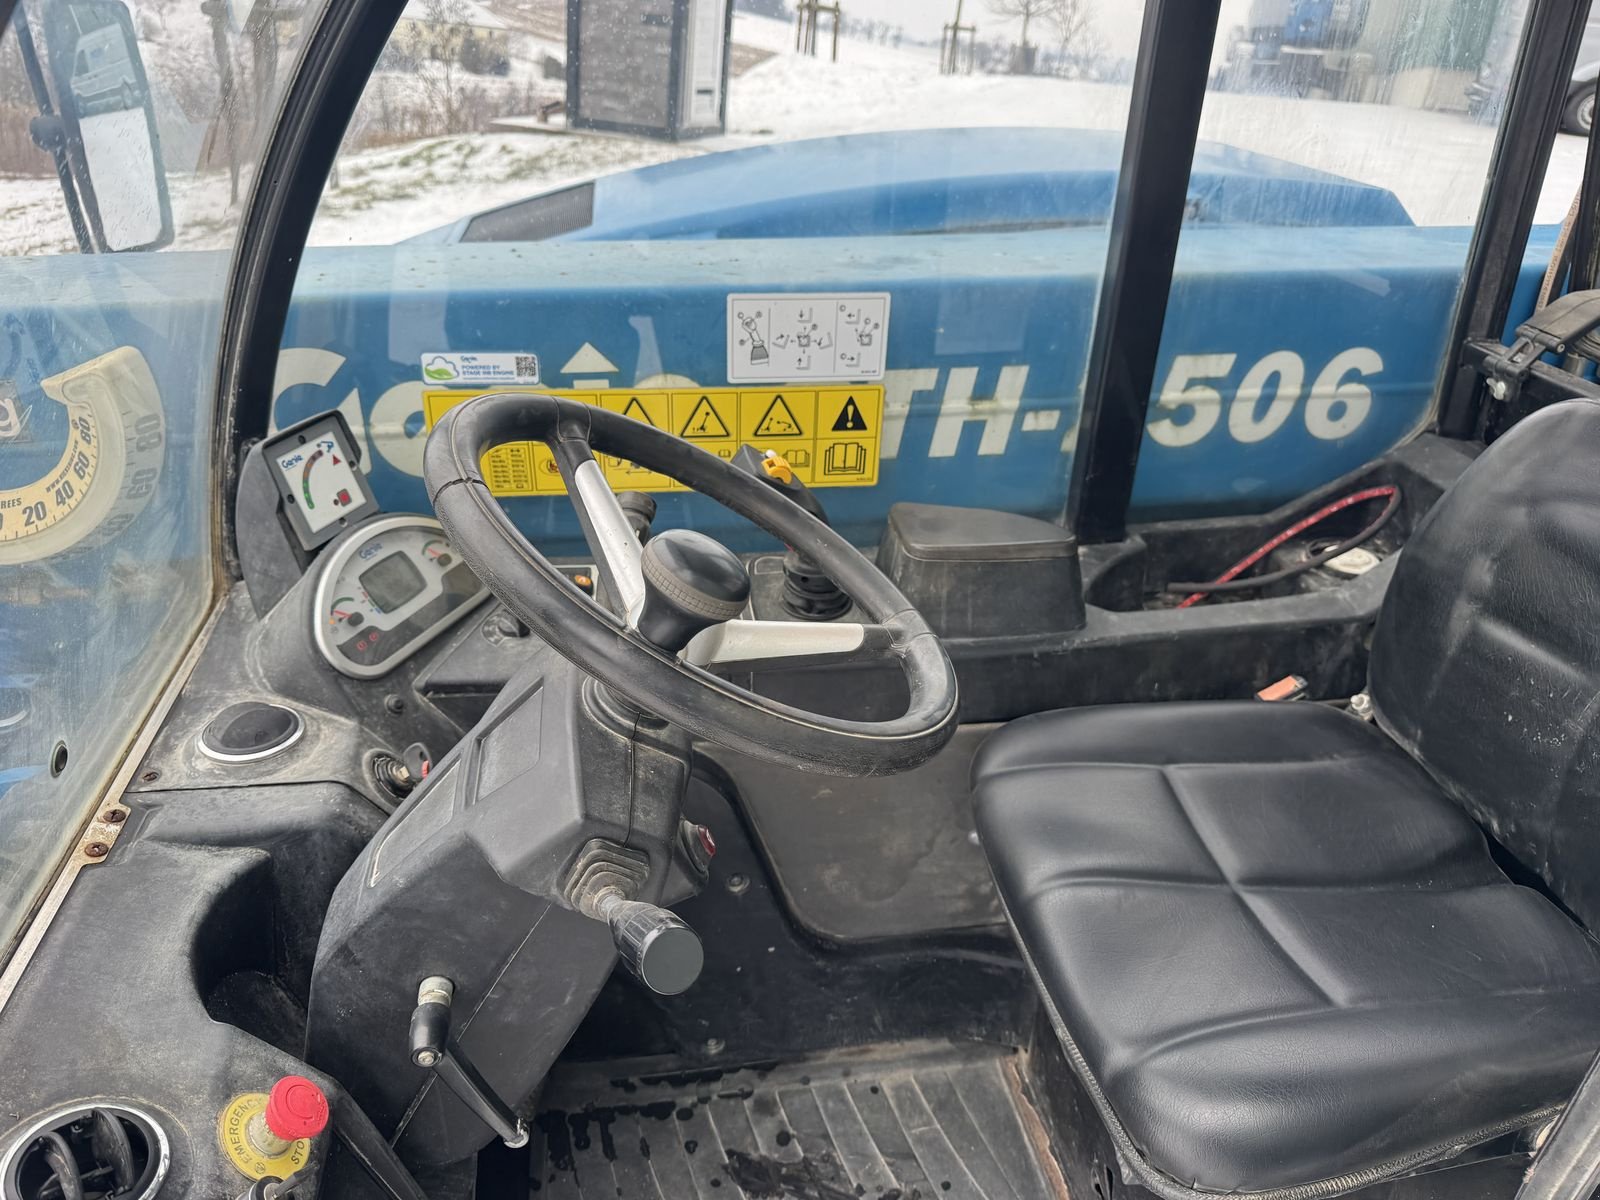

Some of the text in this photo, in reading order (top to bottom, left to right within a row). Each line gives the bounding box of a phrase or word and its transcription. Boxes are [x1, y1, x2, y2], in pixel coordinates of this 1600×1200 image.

[879, 346, 1385, 459] TH-506
[78, 417, 92, 445] 80
[74, 451, 90, 480] 60
[281, 454, 303, 471] Genie
[0, 498, 22, 509] REES
[55, 480, 75, 506] 40
[22, 501, 47, 527] 20
[229, 1097, 305, 1165] EMERGENC STO
